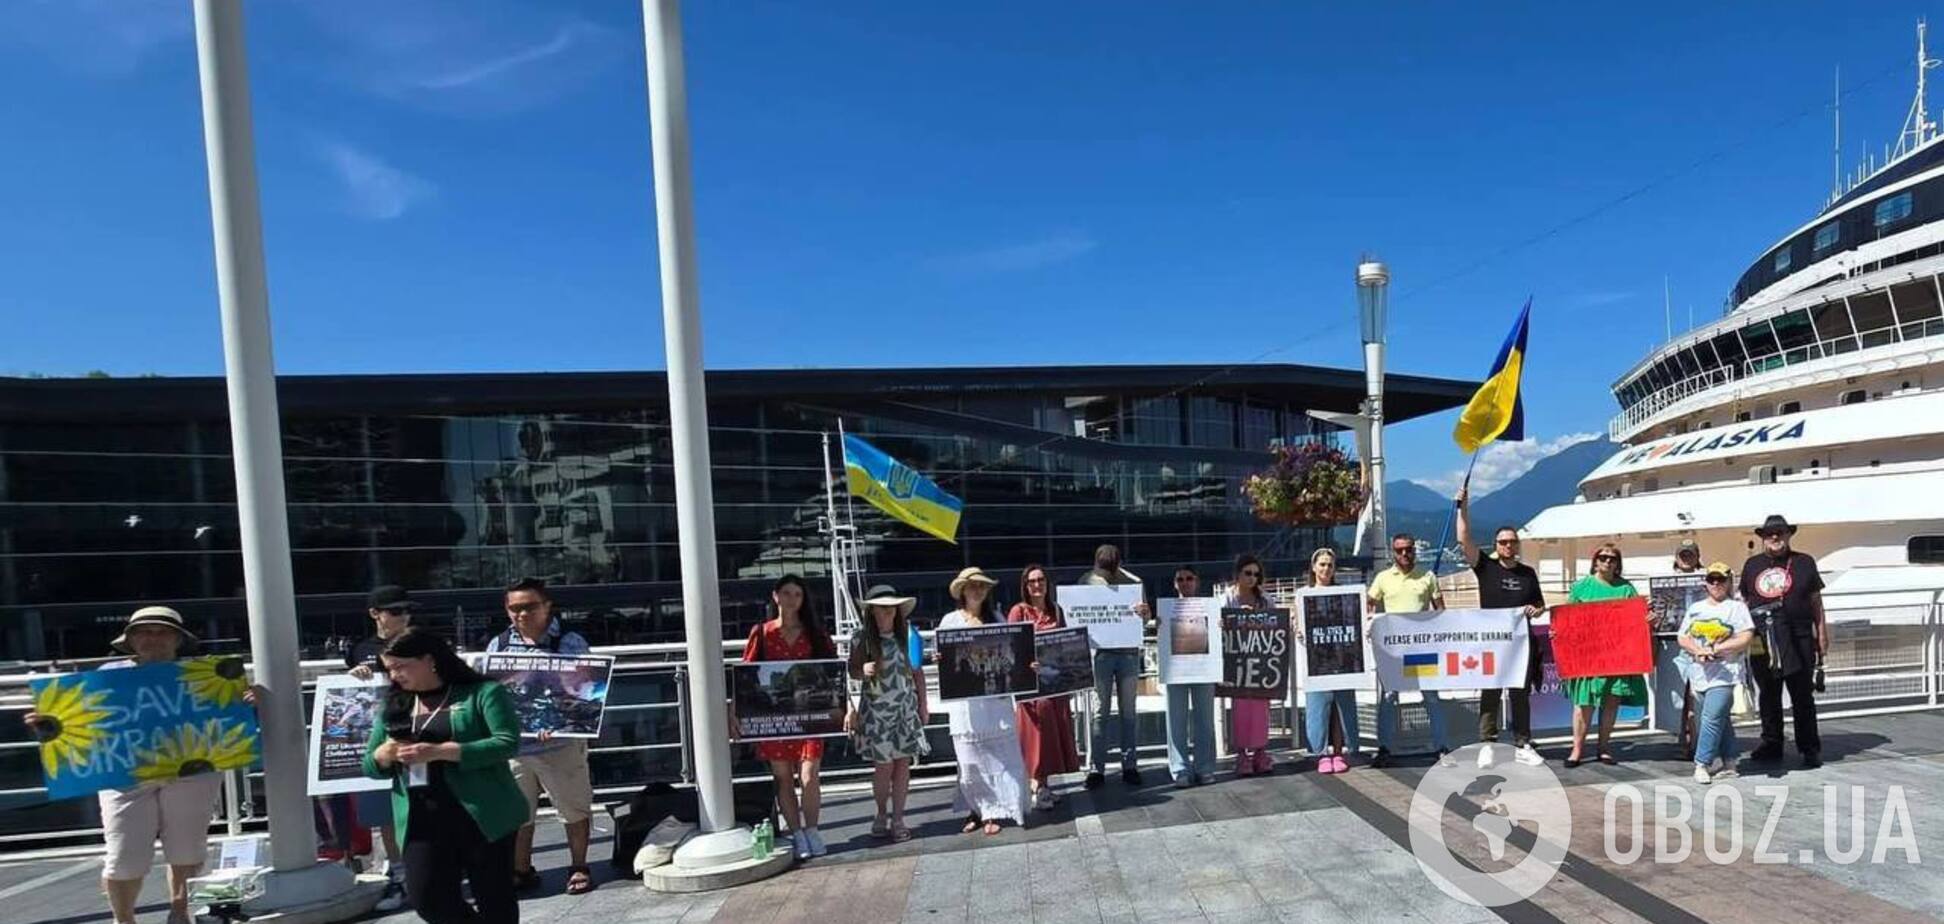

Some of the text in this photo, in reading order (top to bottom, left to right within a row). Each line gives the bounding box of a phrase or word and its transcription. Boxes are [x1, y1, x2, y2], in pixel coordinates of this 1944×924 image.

[1660, 420, 1806, 459] ALASKA
[1222, 629, 1286, 656] ALWAYS
[1312, 627, 1325, 636] ALL
[1383, 631, 1513, 645] PLEASE KEEP SUPPORTING UKRAINE
[84, 684, 212, 729] SAVE
